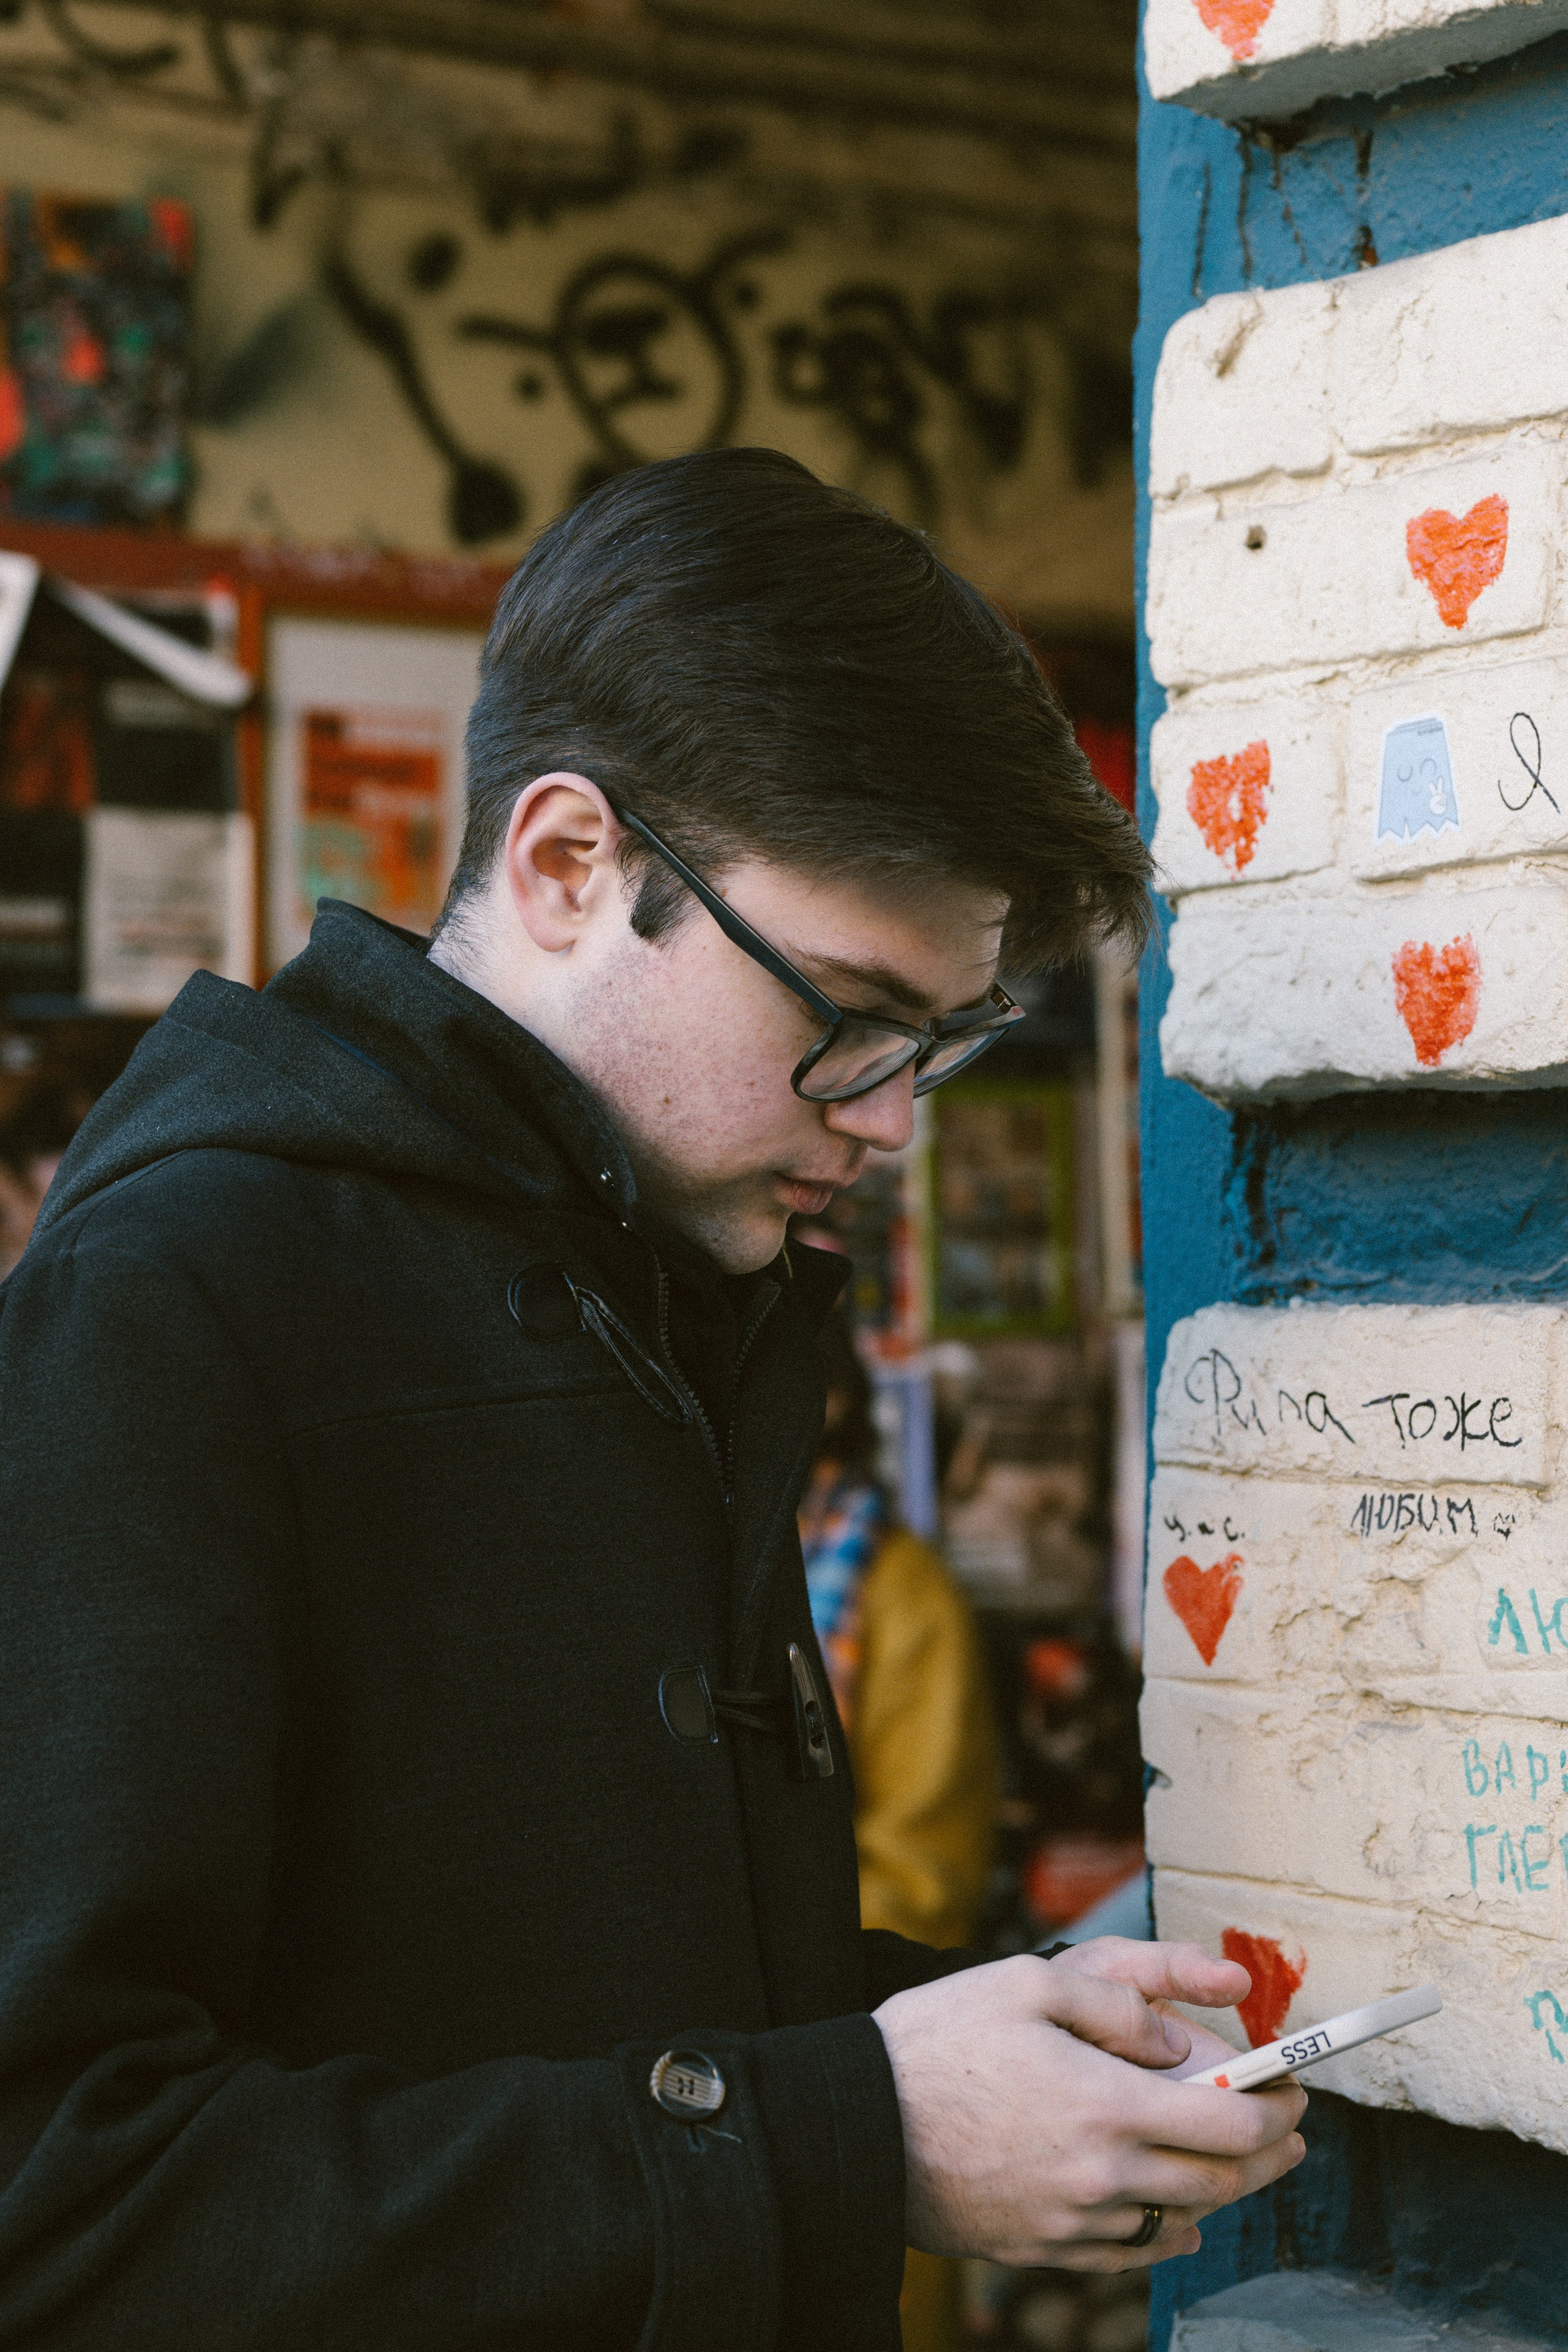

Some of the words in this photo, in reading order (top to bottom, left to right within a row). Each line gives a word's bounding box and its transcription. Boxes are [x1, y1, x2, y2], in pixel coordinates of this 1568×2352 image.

[1462, 1738, 1568, 1802] ВАР
[1463, 1823, 1568, 1893] ГЛЕ
[1281, 2030, 1332, 2065] LESS
